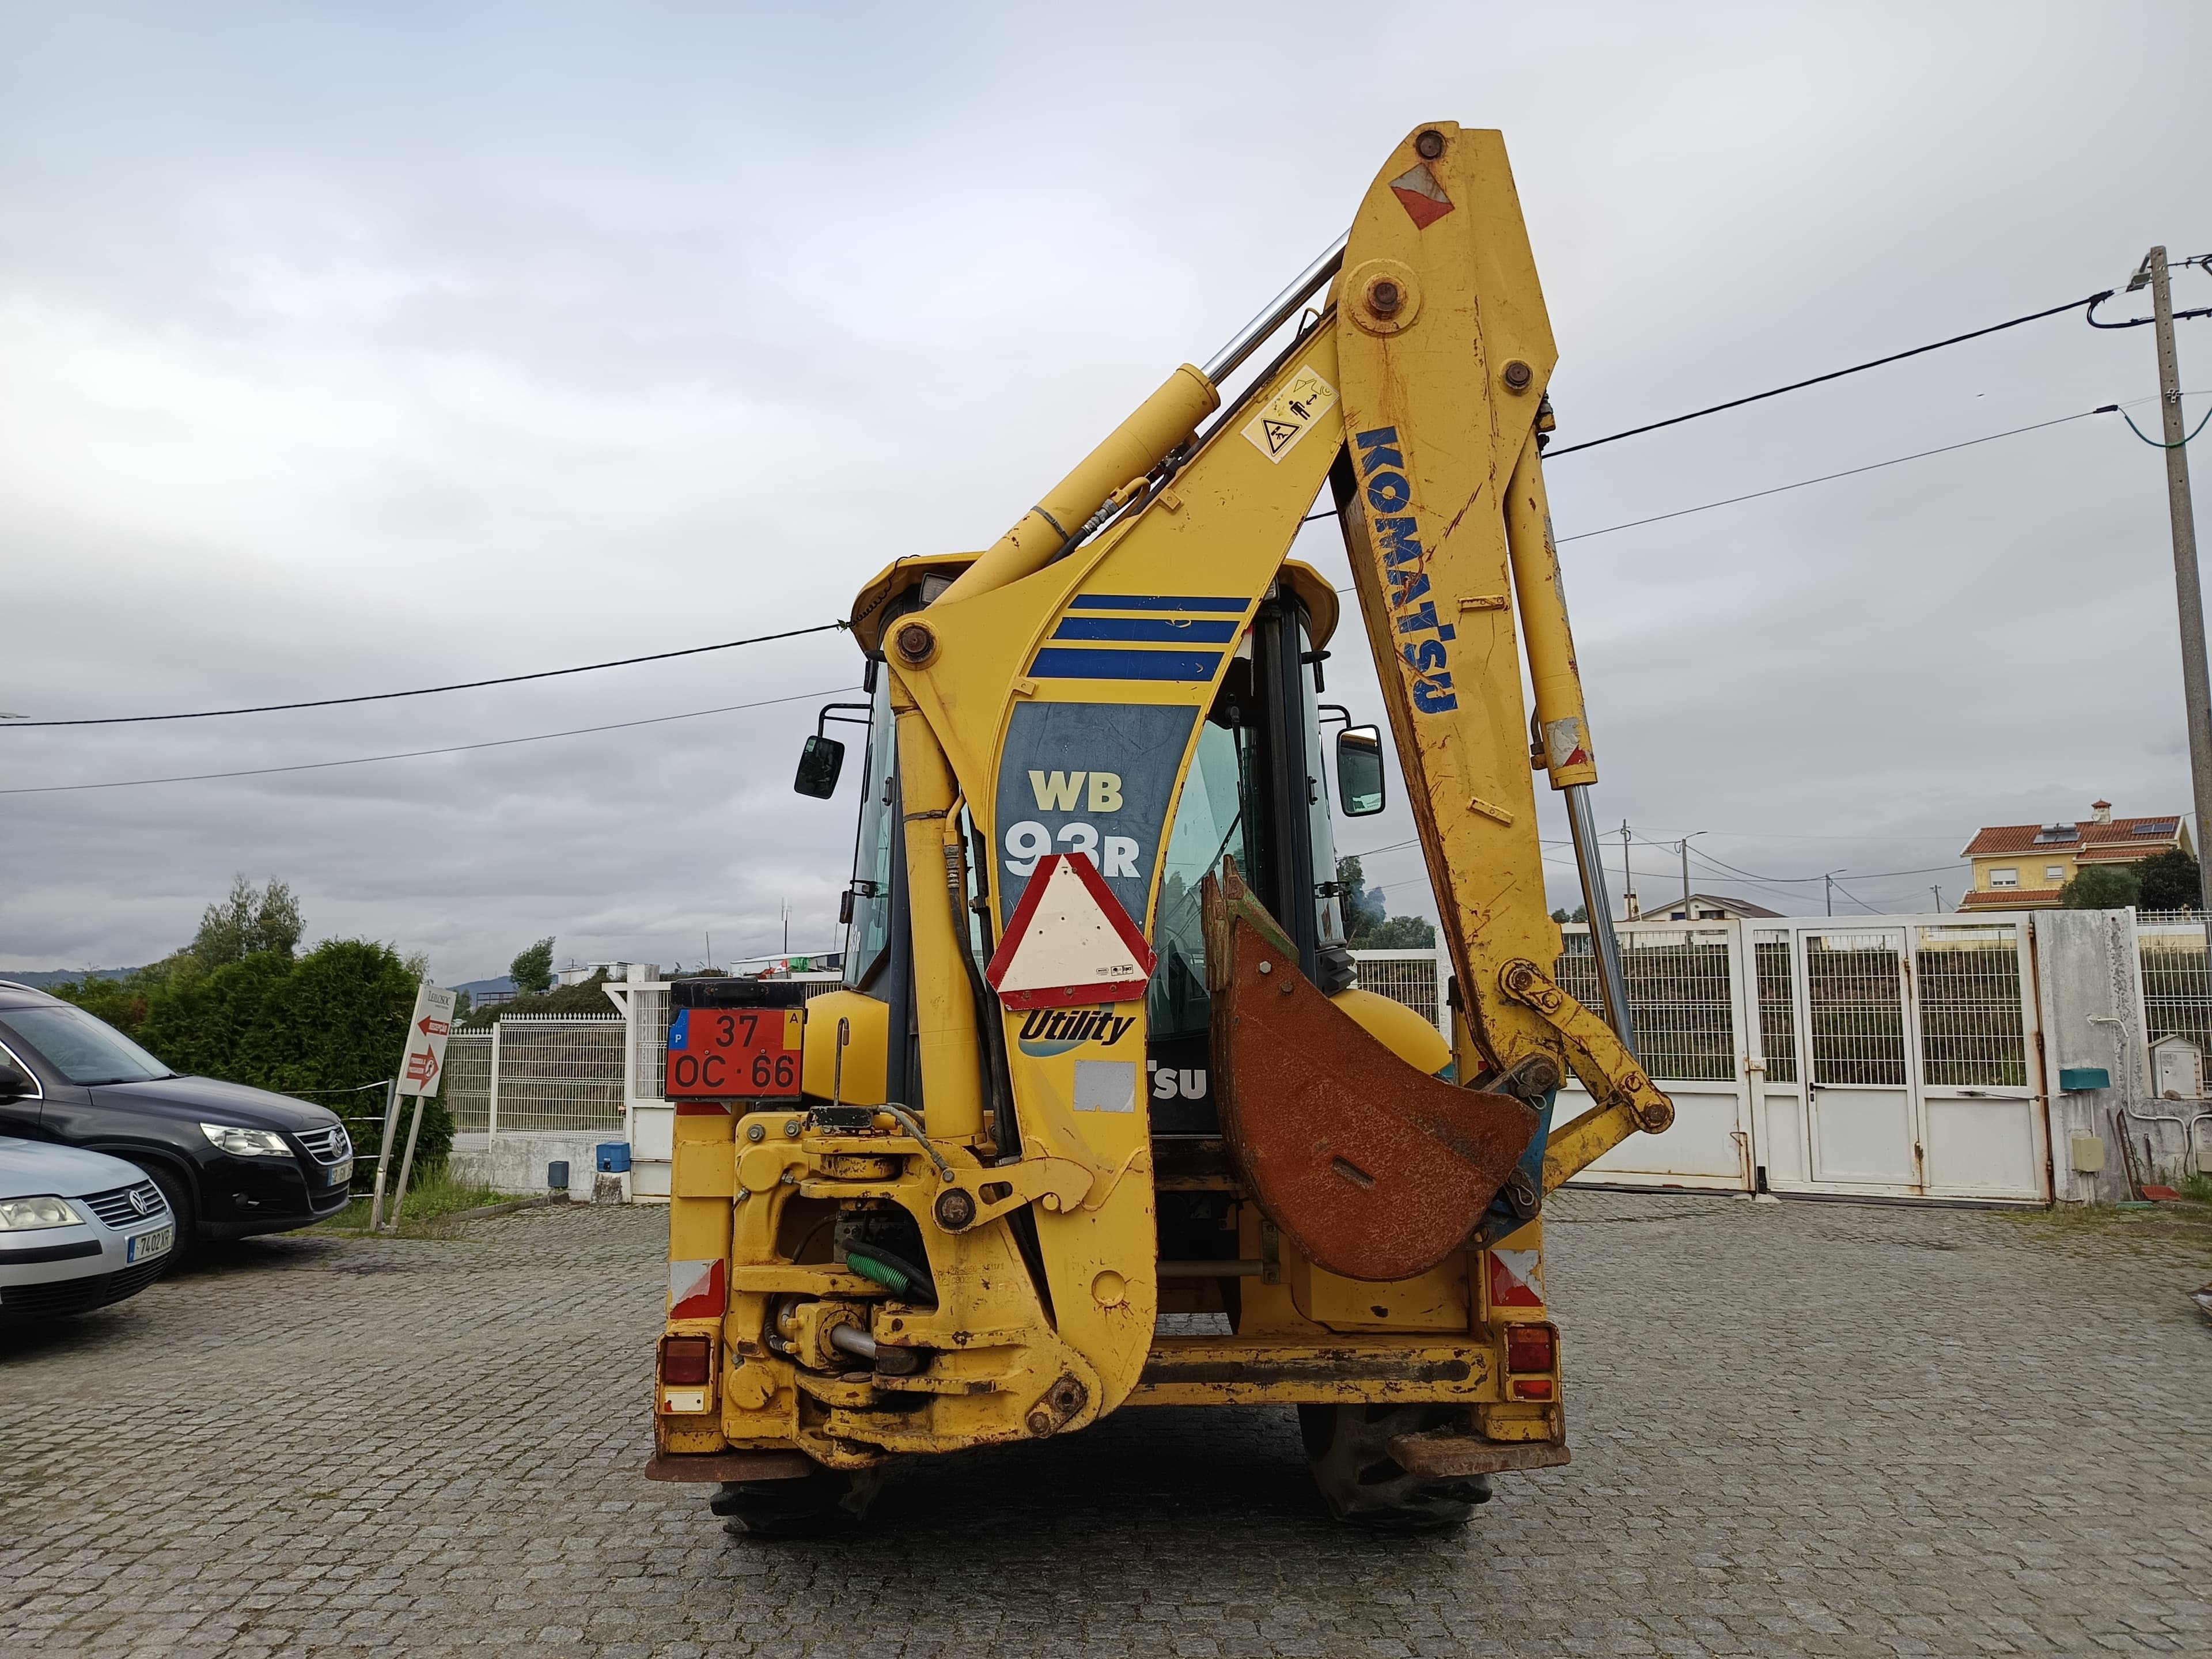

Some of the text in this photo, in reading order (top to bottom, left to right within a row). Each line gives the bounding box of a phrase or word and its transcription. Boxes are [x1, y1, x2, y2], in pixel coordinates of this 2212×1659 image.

[1356, 426, 1459, 714] KOMATSU
[1028, 770, 1124, 813] WB
[1005, 820, 1141, 878] 93R
[715, 1015, 758, 1047] 37
[789, 1013, 798, 1023] A
[1019, 1009, 1137, 1046] Utility
[675, 1034, 681, 1043] P
[1147, 1060, 1206, 1100] SU
